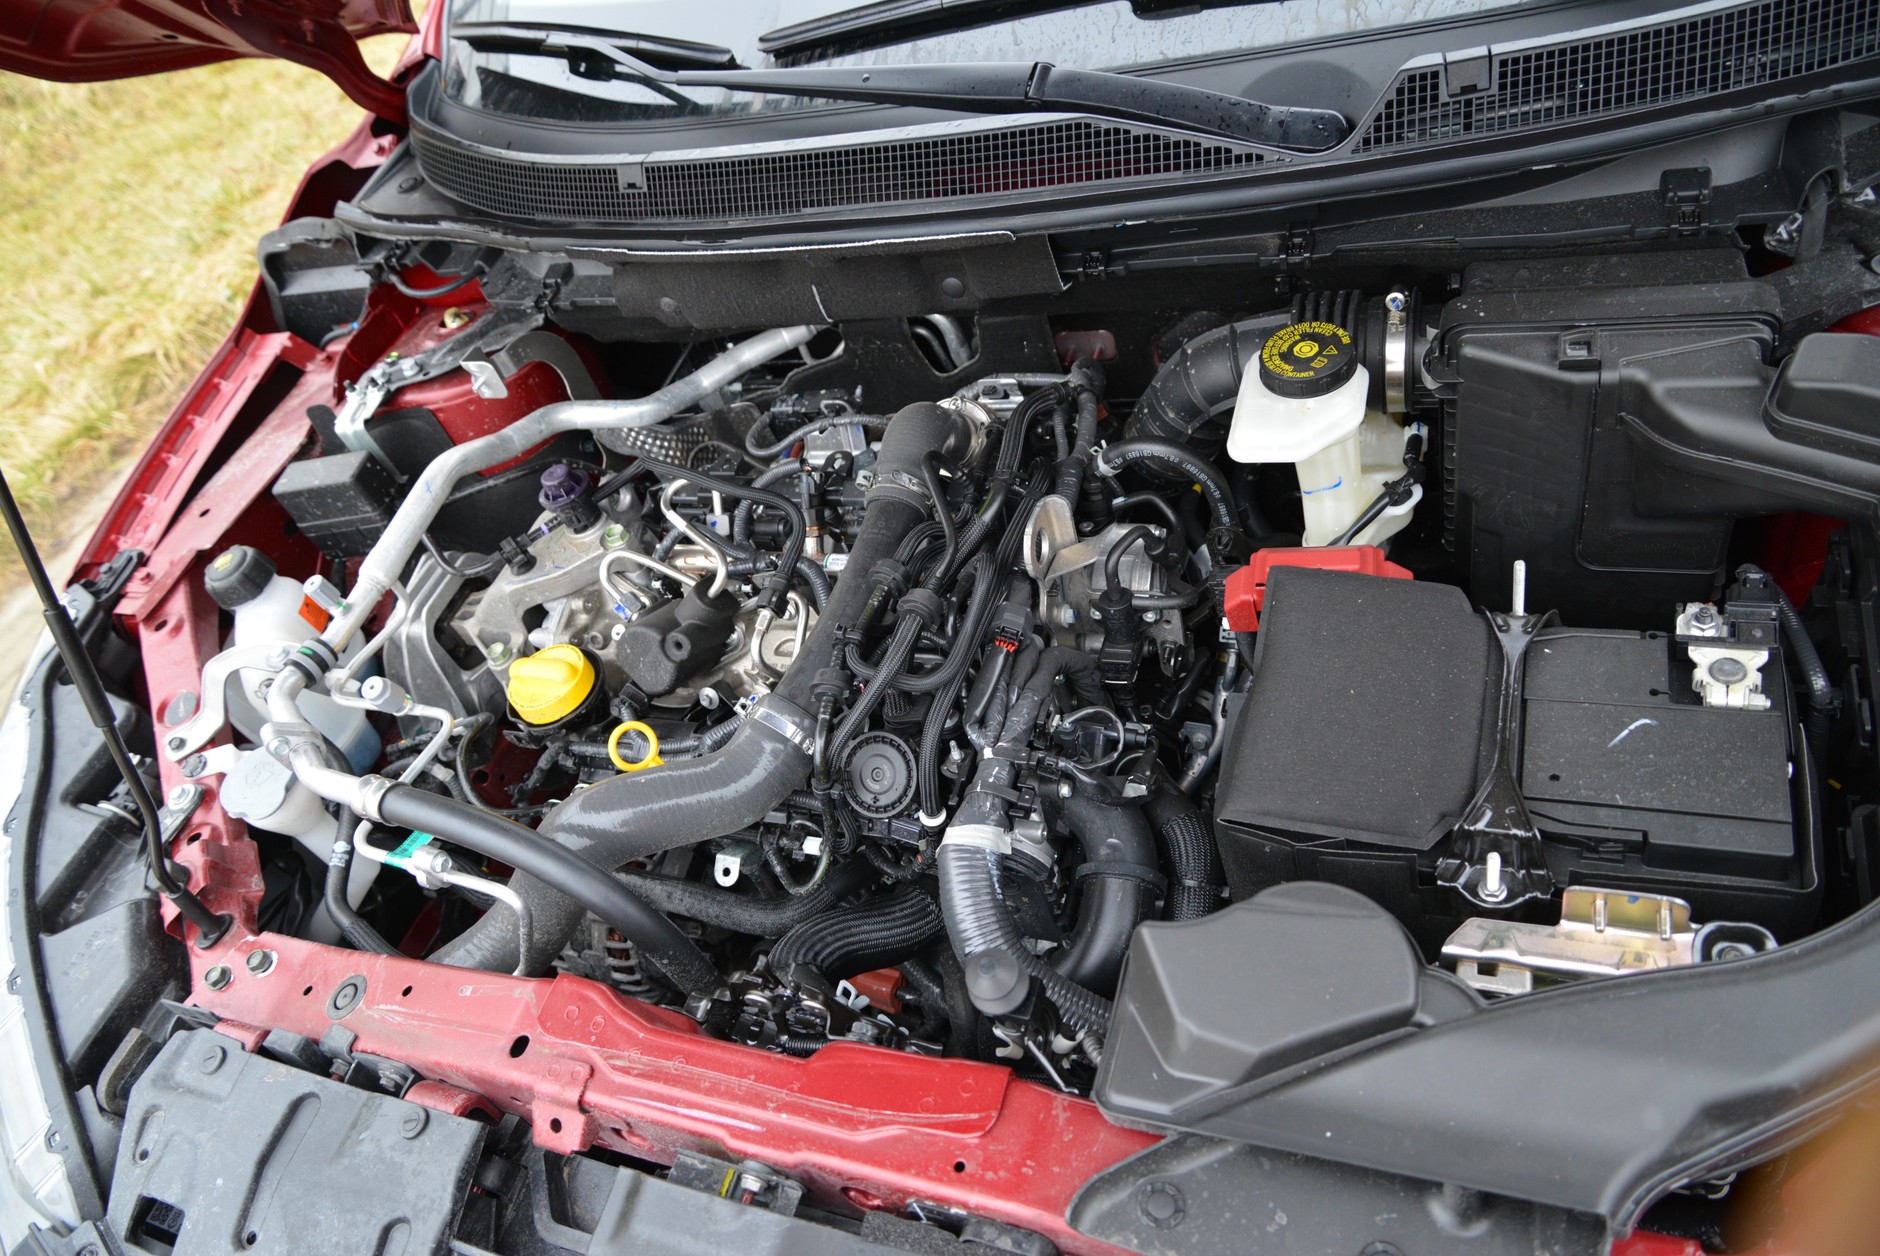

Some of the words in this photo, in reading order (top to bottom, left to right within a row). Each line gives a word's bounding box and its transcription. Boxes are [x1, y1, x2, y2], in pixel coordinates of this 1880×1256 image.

[1280, 370, 1315, 378] CONTAINER
[1125, 450, 1151, 460] GB16897
[1182, 462, 1208, 482] GB16897
